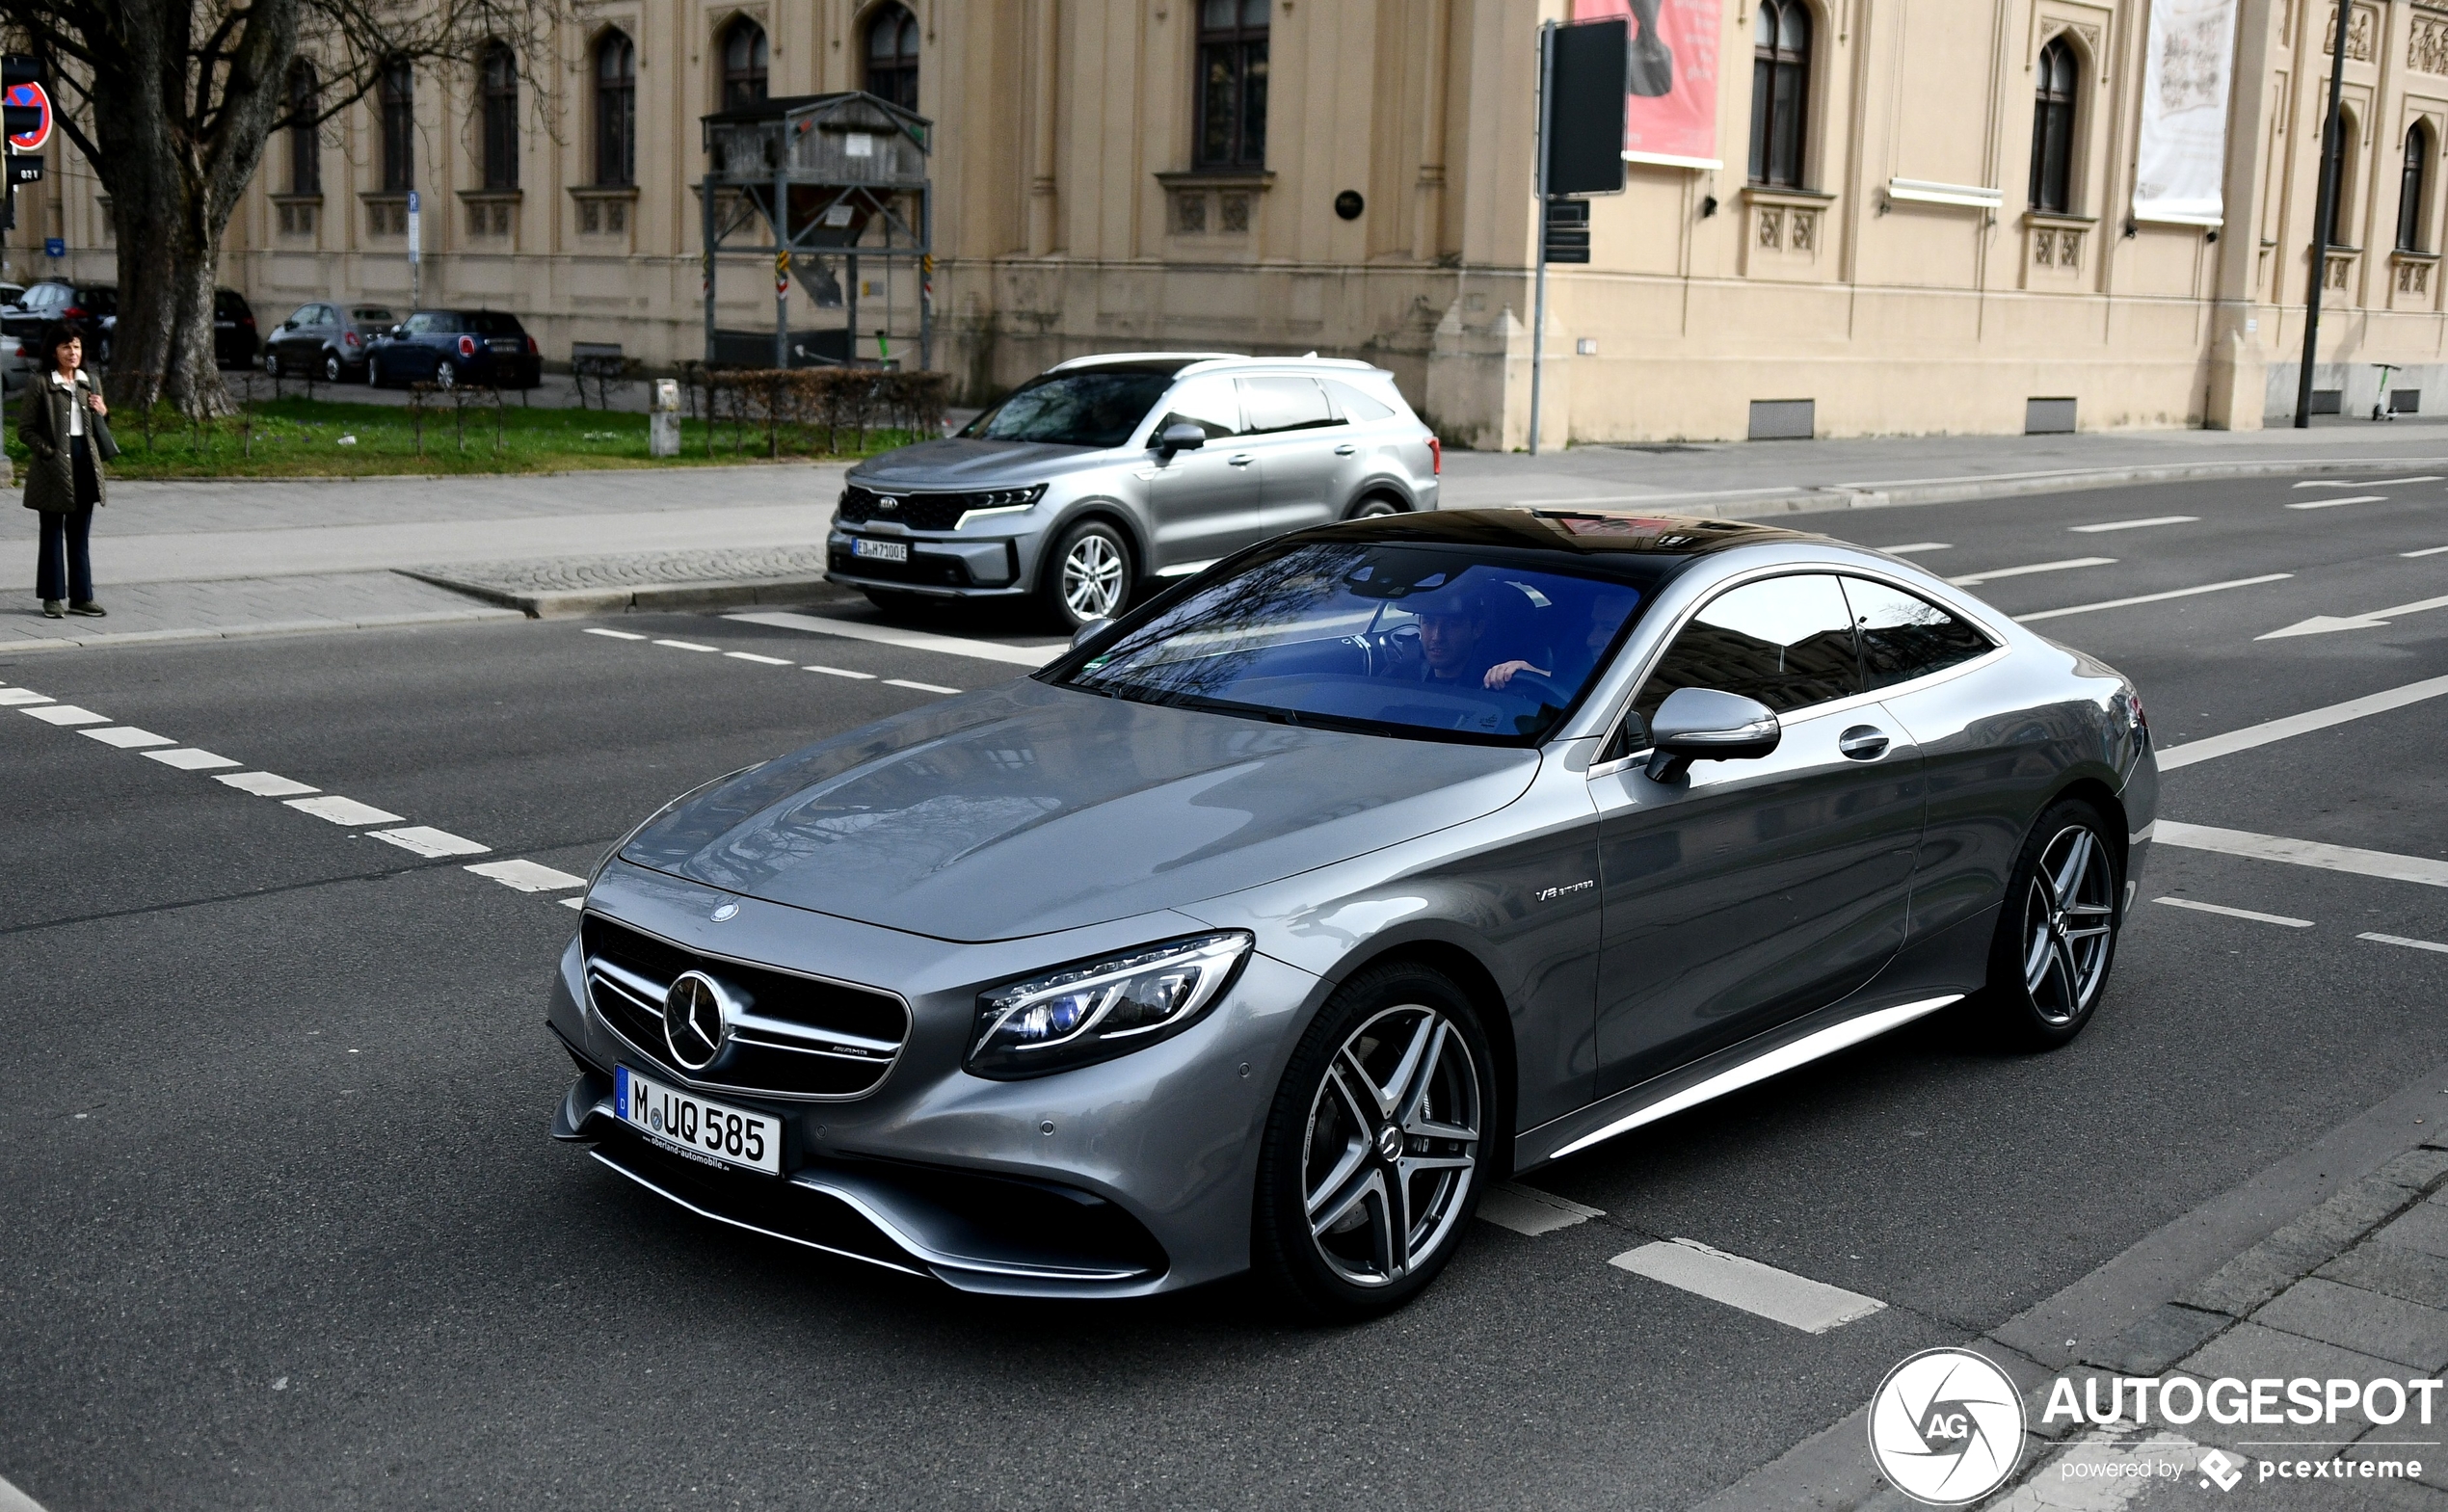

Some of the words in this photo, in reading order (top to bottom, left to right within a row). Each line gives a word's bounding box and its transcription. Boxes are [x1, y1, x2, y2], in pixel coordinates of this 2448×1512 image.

[410, 193, 416, 212] P
[880, 499, 894, 509] KIA
[857, 541, 868, 555] ED
[1535, 888, 1557, 902] V8
[634, 1080, 648, 1125] M
[664, 1093, 699, 1145] UQ
[705, 1106, 765, 1162] 585
